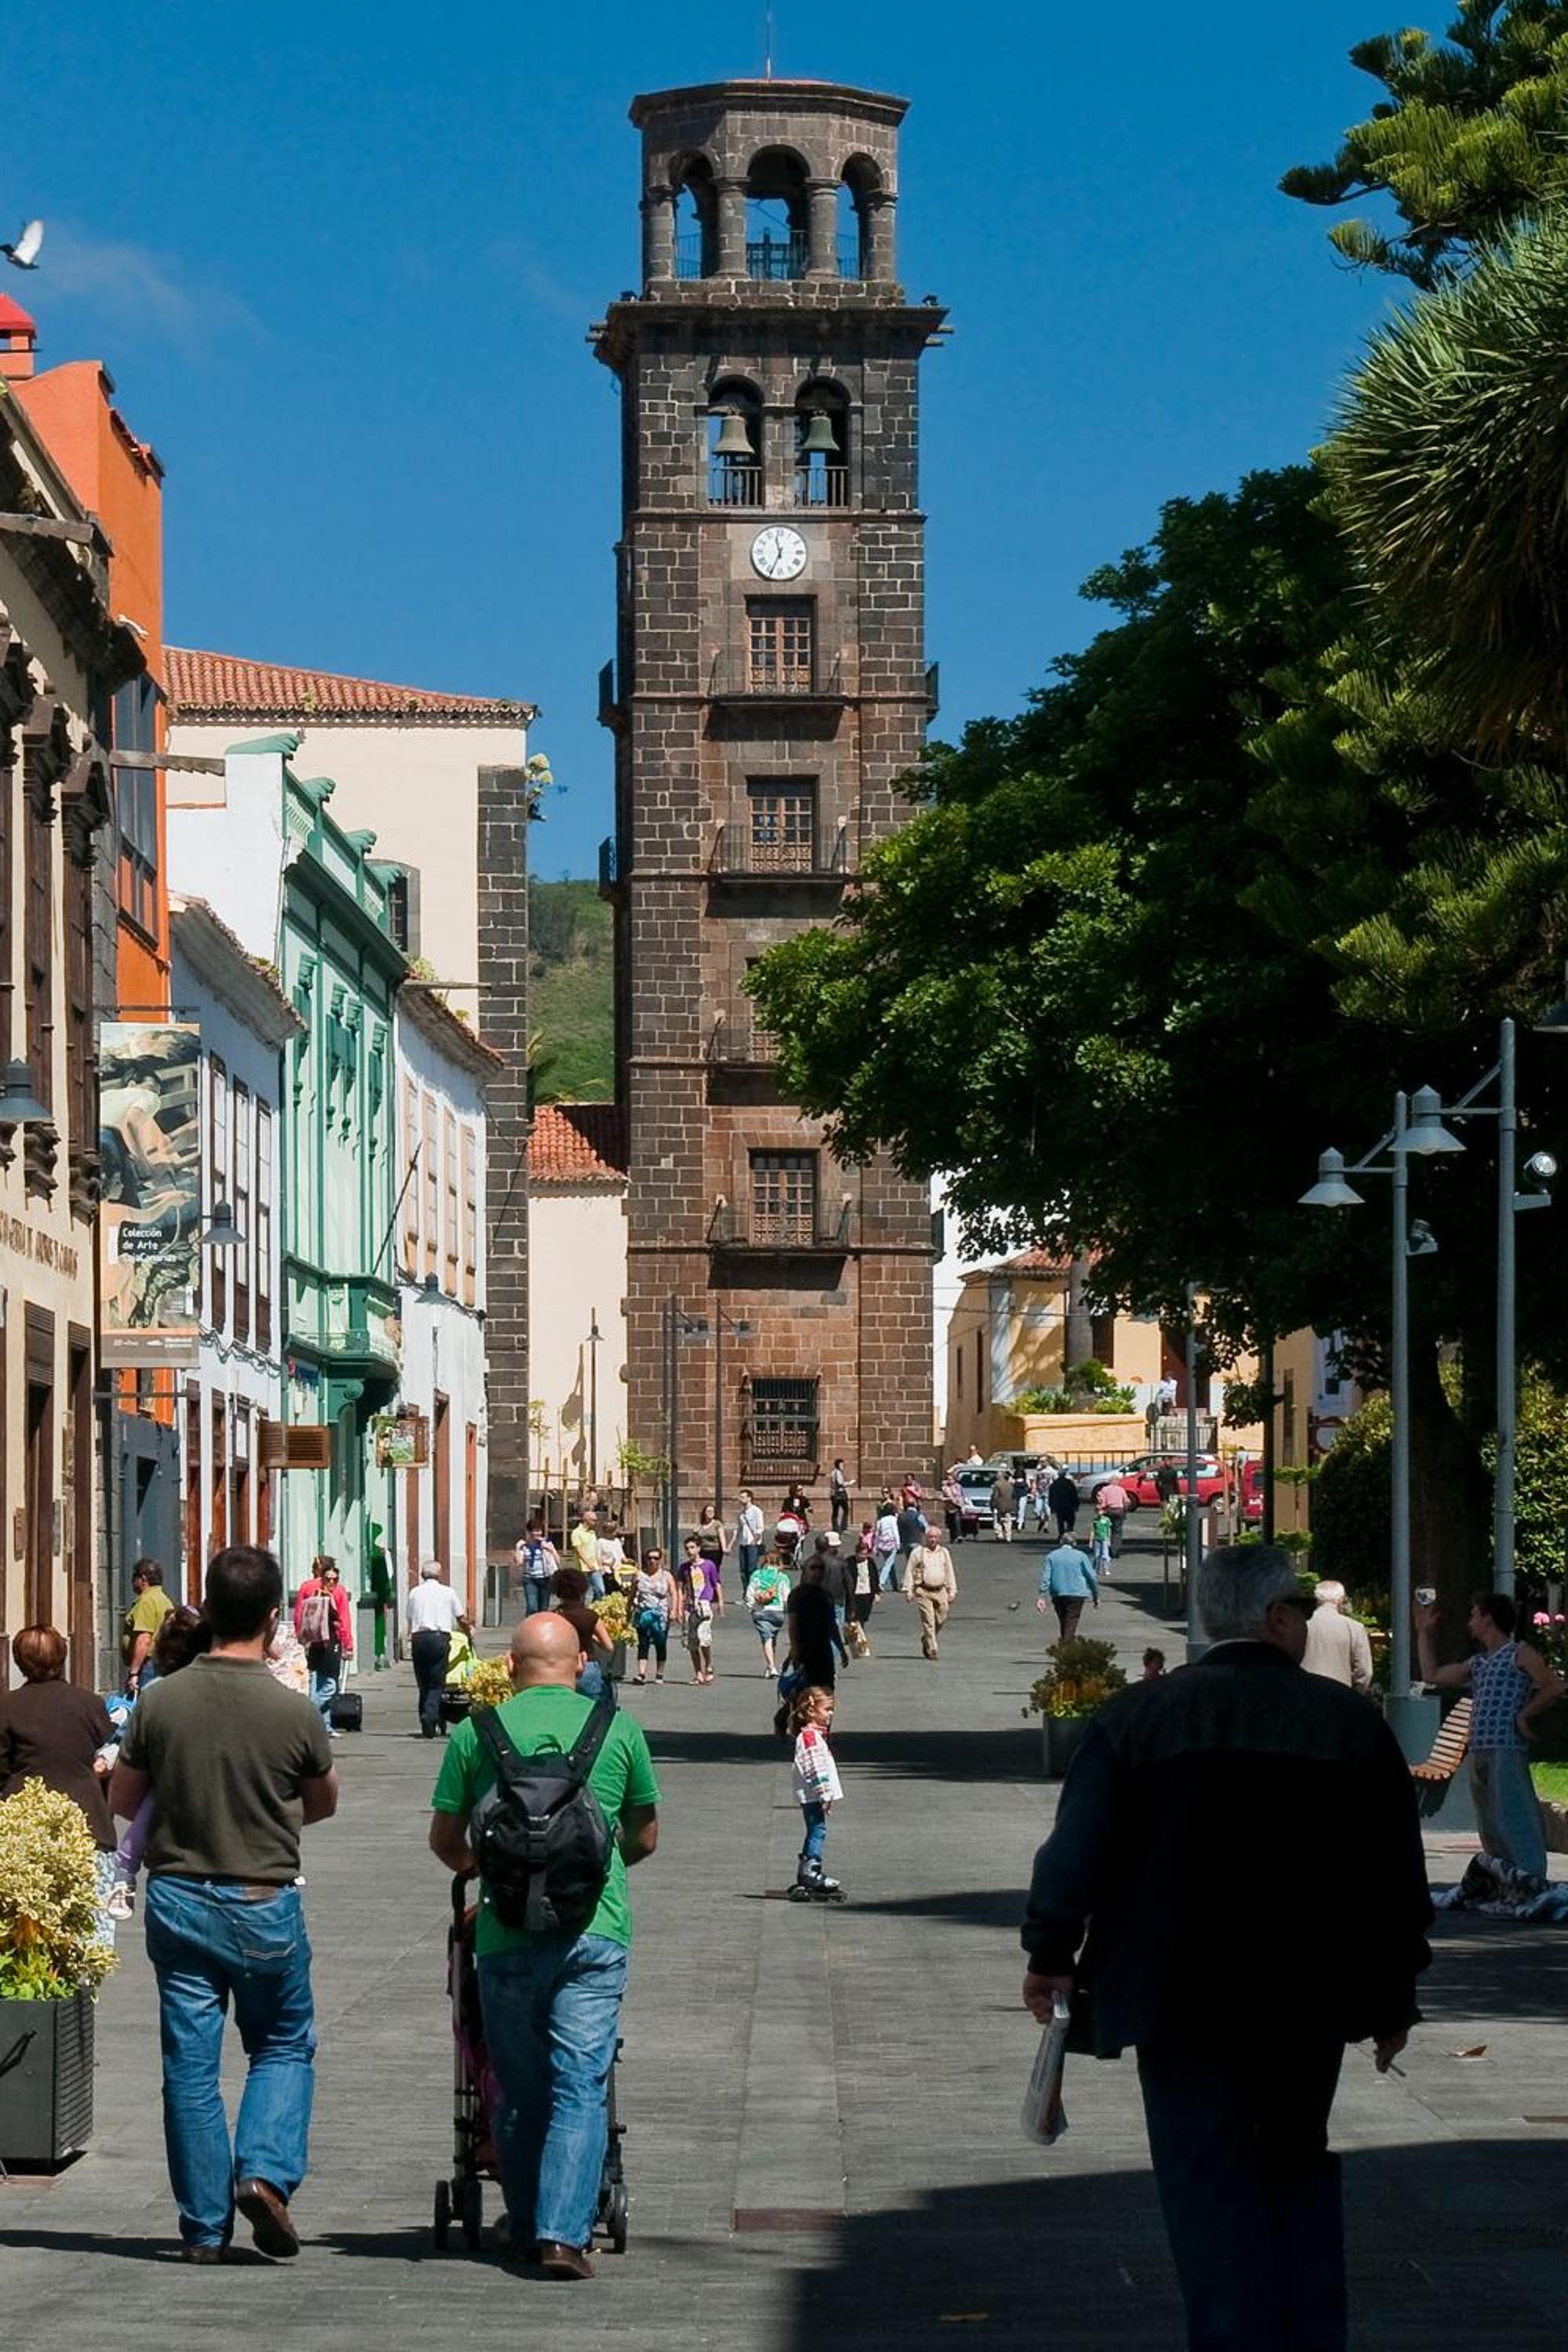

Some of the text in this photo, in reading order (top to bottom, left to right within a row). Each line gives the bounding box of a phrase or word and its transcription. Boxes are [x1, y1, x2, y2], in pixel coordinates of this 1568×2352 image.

[122, 1227, 162, 1238] Colección
[122, 1240, 159, 1250] de Arte
